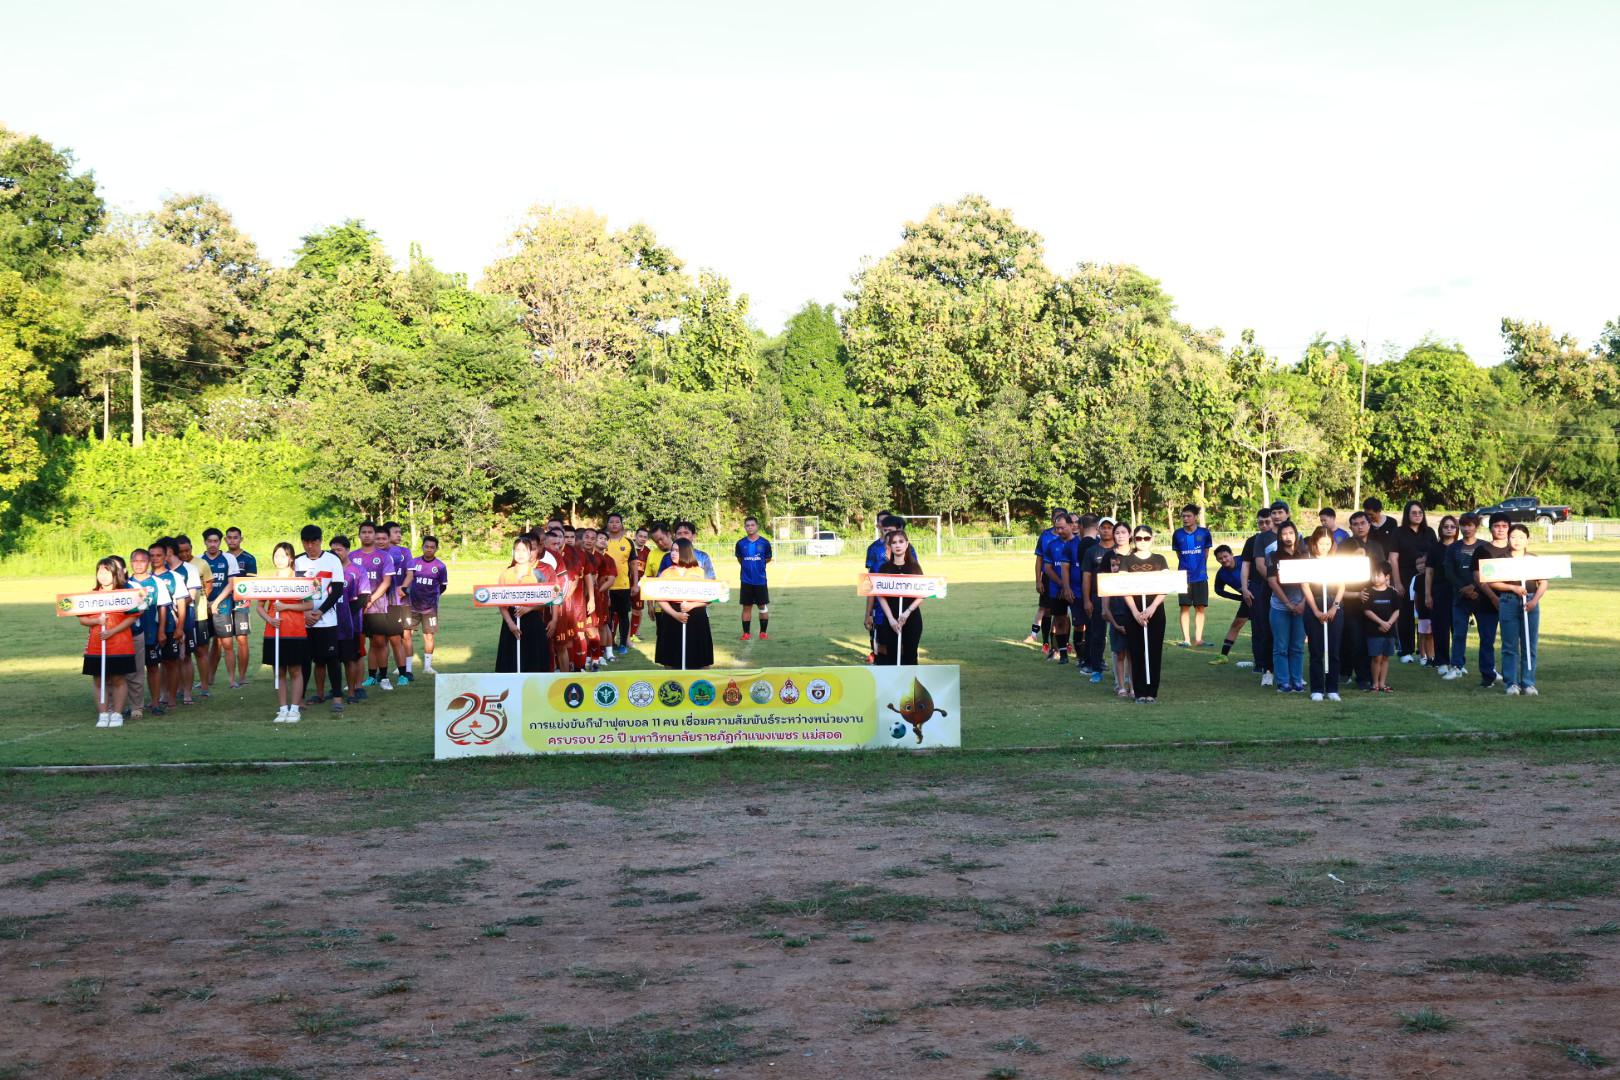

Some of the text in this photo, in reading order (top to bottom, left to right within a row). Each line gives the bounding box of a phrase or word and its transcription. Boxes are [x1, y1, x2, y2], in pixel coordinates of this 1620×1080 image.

[529, 717, 649, 731] การแข่งขันกีฬาฟุตบอล
[652, 717, 661, 727] 11
[663, 717, 678, 727] คน
[548, 735, 596, 745] ครบรอบ
[598, 733, 614, 744] 25
[617, 732, 627, 744] ปี
[802, 728, 842, 741] แม่สอด
